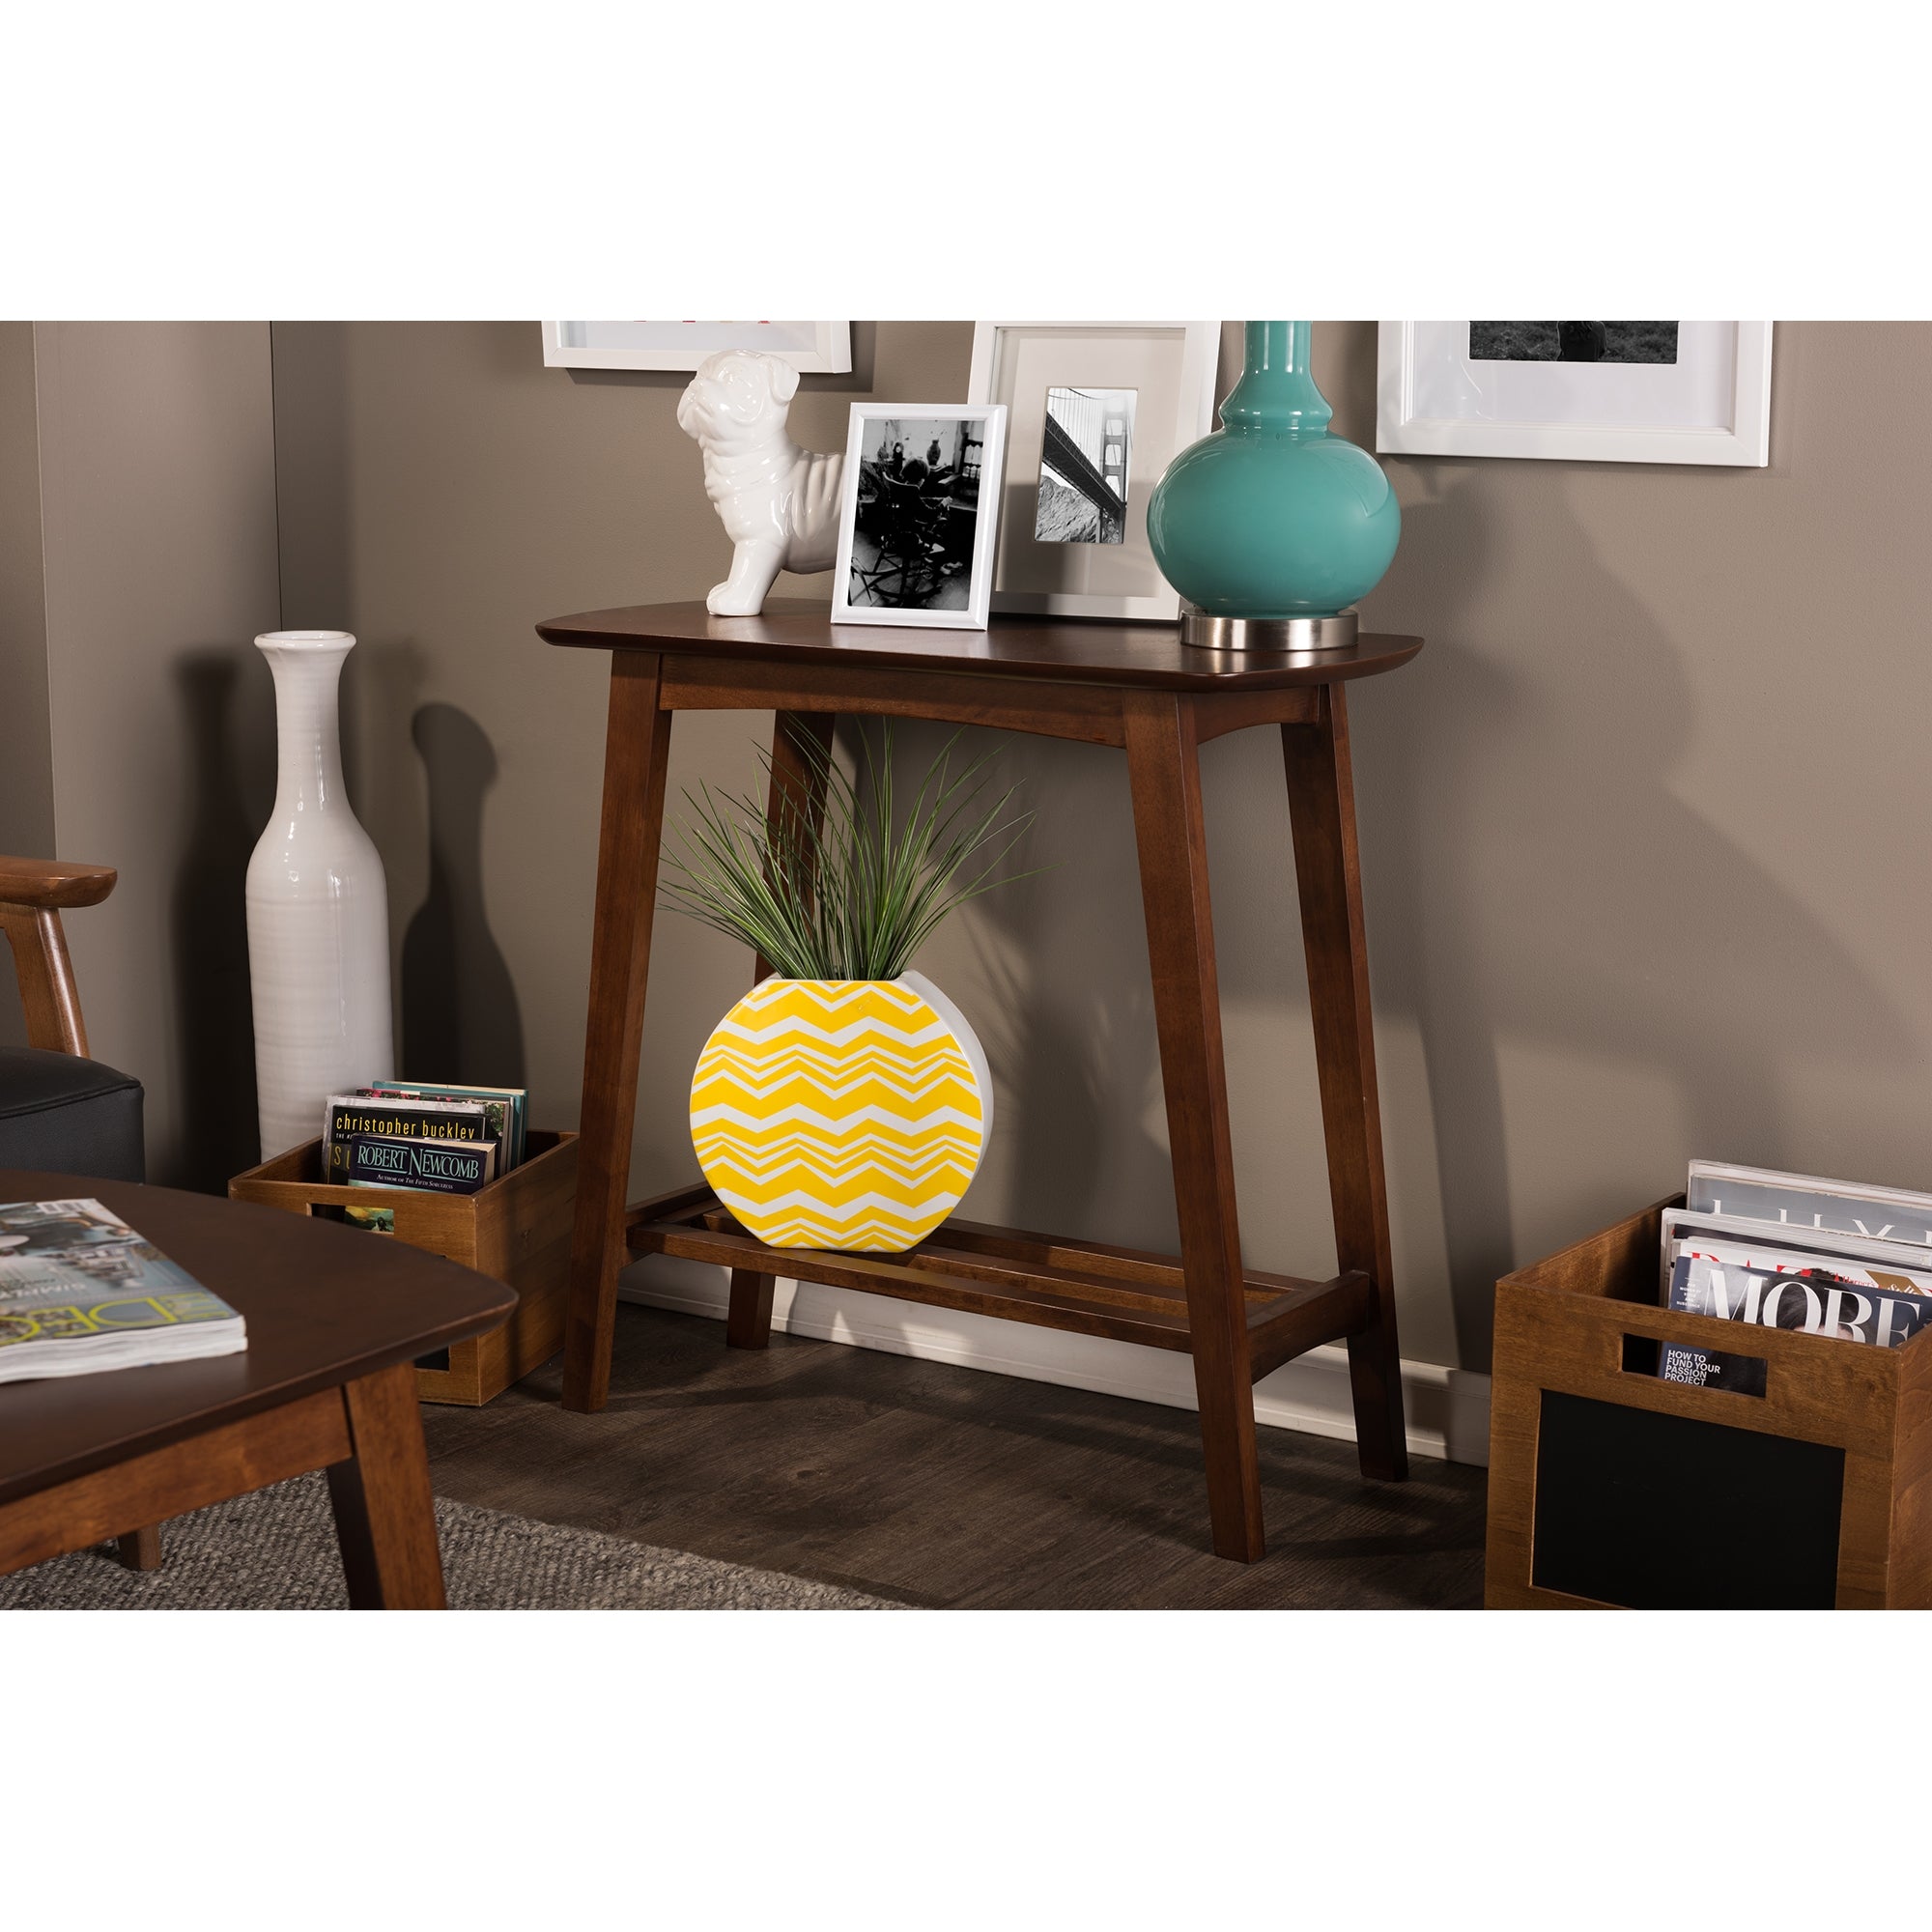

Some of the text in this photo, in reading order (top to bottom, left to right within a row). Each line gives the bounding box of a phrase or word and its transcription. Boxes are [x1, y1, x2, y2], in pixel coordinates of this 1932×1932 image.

[336, 1113, 475, 1140] christopher buckley
[357, 1145, 479, 1179] ROBERT NEWCOMB
[1703, 1268, 1920, 1348] MORE
[1667, 1350, 1707, 1363] HOW TO
[1665, 1364, 1707, 1378] PASSION
[1666, 1357, 1720, 1374] FUND YOUR
[1664, 1372, 1707, 1386] PROJECT
